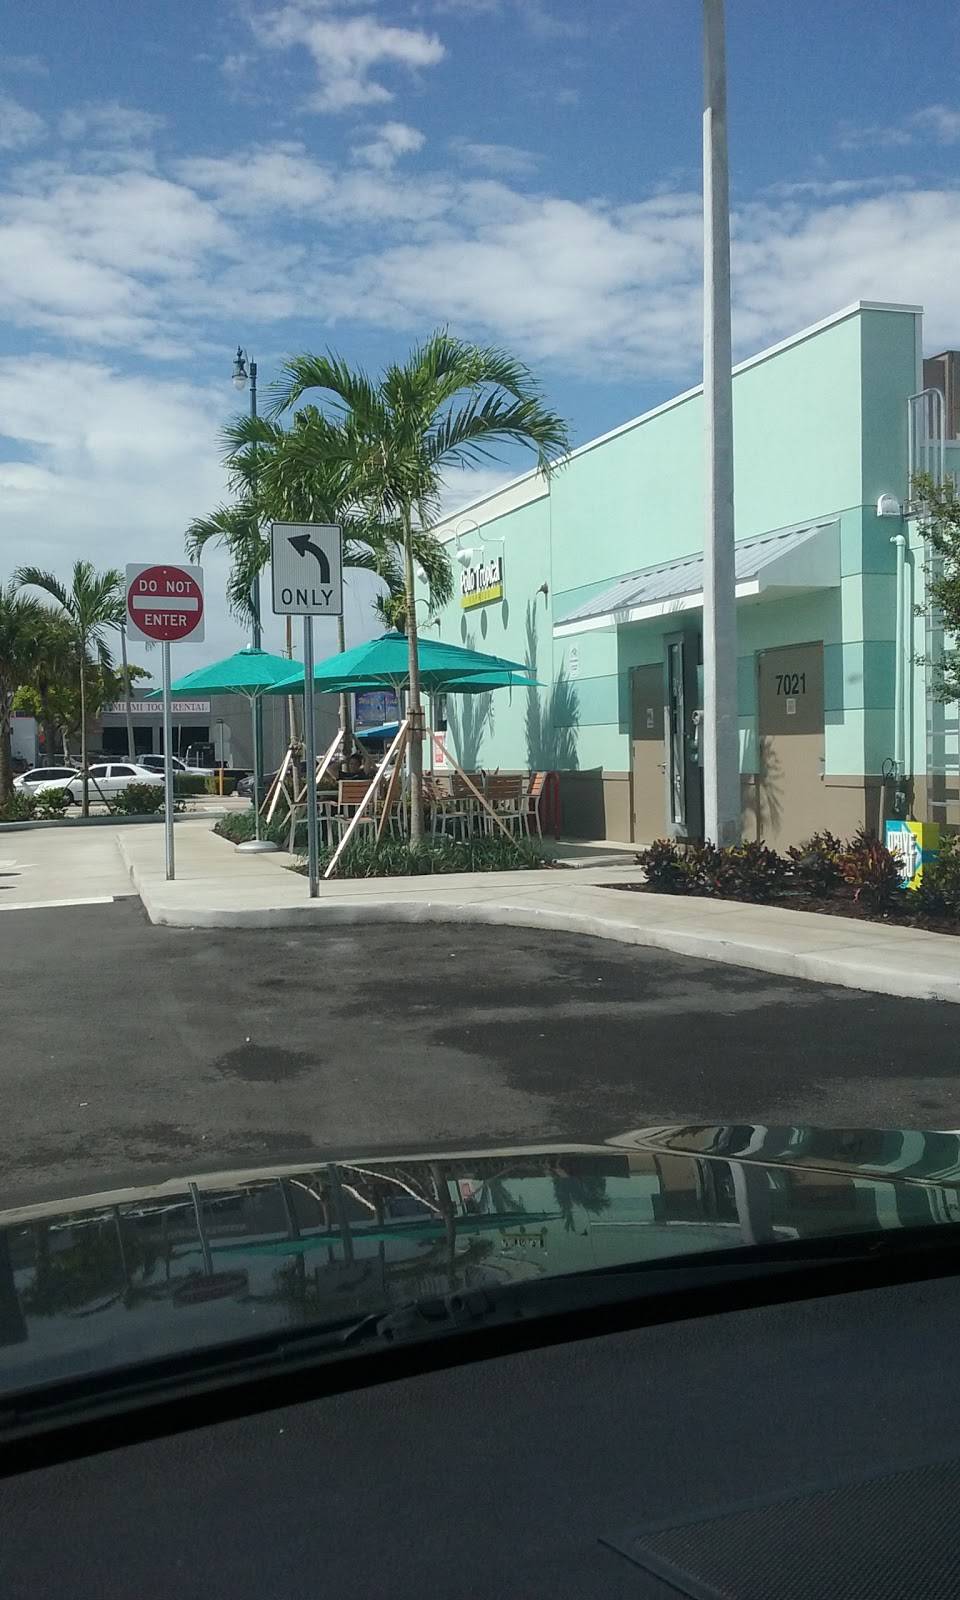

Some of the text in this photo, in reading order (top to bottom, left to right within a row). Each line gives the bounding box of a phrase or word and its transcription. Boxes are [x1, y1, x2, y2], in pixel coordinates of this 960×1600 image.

[139, 580, 192, 593] DO NOT
[281, 588, 333, 606] ONLY
[144, 614, 187, 626] ENTER
[775, 672, 806, 696] 7021
[112, 702, 207, 712] MIMI TOO RENTAL
